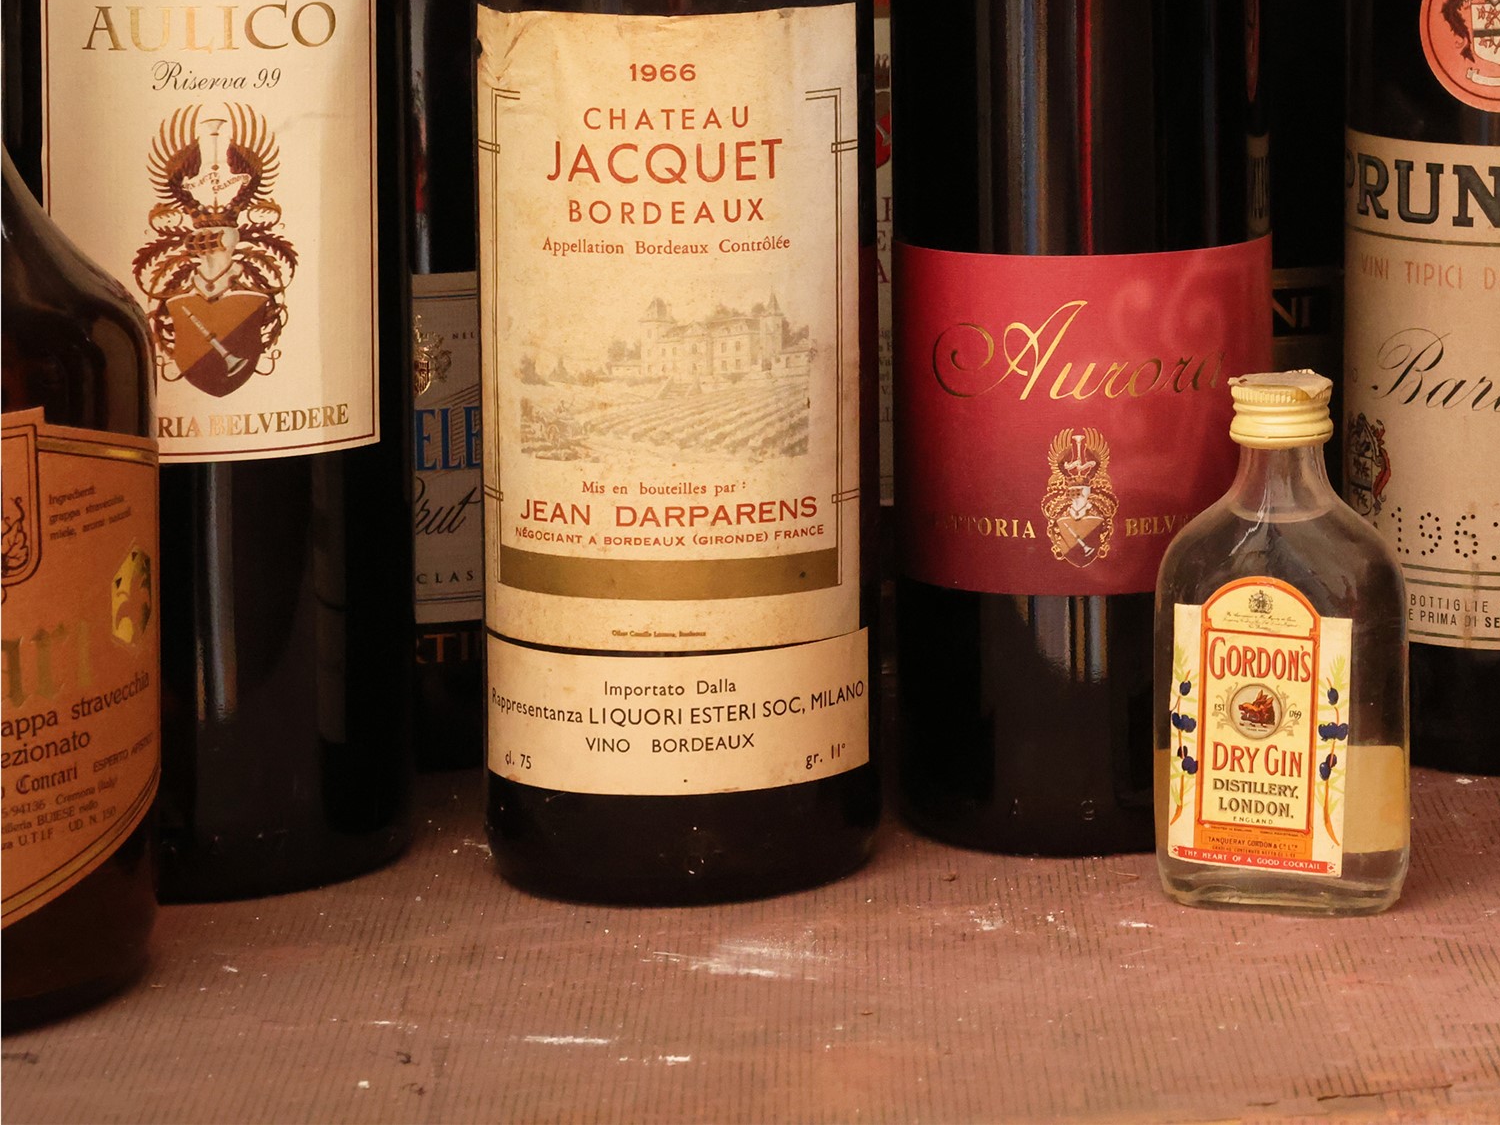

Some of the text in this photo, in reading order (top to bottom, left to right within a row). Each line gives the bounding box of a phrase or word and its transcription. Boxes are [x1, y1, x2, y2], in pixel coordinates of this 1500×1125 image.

[82, 0, 337, 54] AULICO
[152, 60, 282, 92] Riserva 99
[629, 62, 698, 83] 1966
[583, 105, 750, 131] CHATEAU
[546, 138, 783, 185] JACQUET
[568, 197, 765, 225] BORDEAUX
[542, 235, 791, 257] Appellation Bordeaux Contrôlée
[1360, 252, 1390, 280] VINI
[1404, 260, 1463, 290] TIPICI
[932, 299, 1228, 402] Aurora
[209, 403, 349, 437] BELVEDERE
[581, 480, 605, 495] Mis
[612, 484, 628, 495] en
[639, 482, 707, 495] bouteilles
[520, 495, 818, 527] JEAN DARPARENS
[515, 524, 825, 547] NÉGOCIANT A BORDEAUX (GIRONDE) FRANCE
[1410, 593, 1488, 613] BOTTIGLIE
[1420, 610, 1457, 626] PRIMA
[1464, 615, 1477, 628] DI
[1208, 636, 1311, 683] GORDON'S
[604, 678, 737, 697] Importato Dalla
[491, 687, 583, 724] Rappresentanza
[588, 707, 682, 728] LIQUORI
[690, 704, 756, 725] ESTERI
[810, 679, 865, 711] MILANO
[585, 732, 756, 754] VINO BORDEAUX
[519, 754, 532, 770] 75
[805, 751, 824, 770] gr.
[1211, 741, 1303, 778] DRY GIN
[1218, 796, 1294, 819] LONDON.
[1233, 815, 1274, 826] ENGLAND
[1203, 852, 1227, 861] HEART
[1257, 857, 1280, 866] GOOD
[1283, 860, 1321, 870] COCKTAIL
